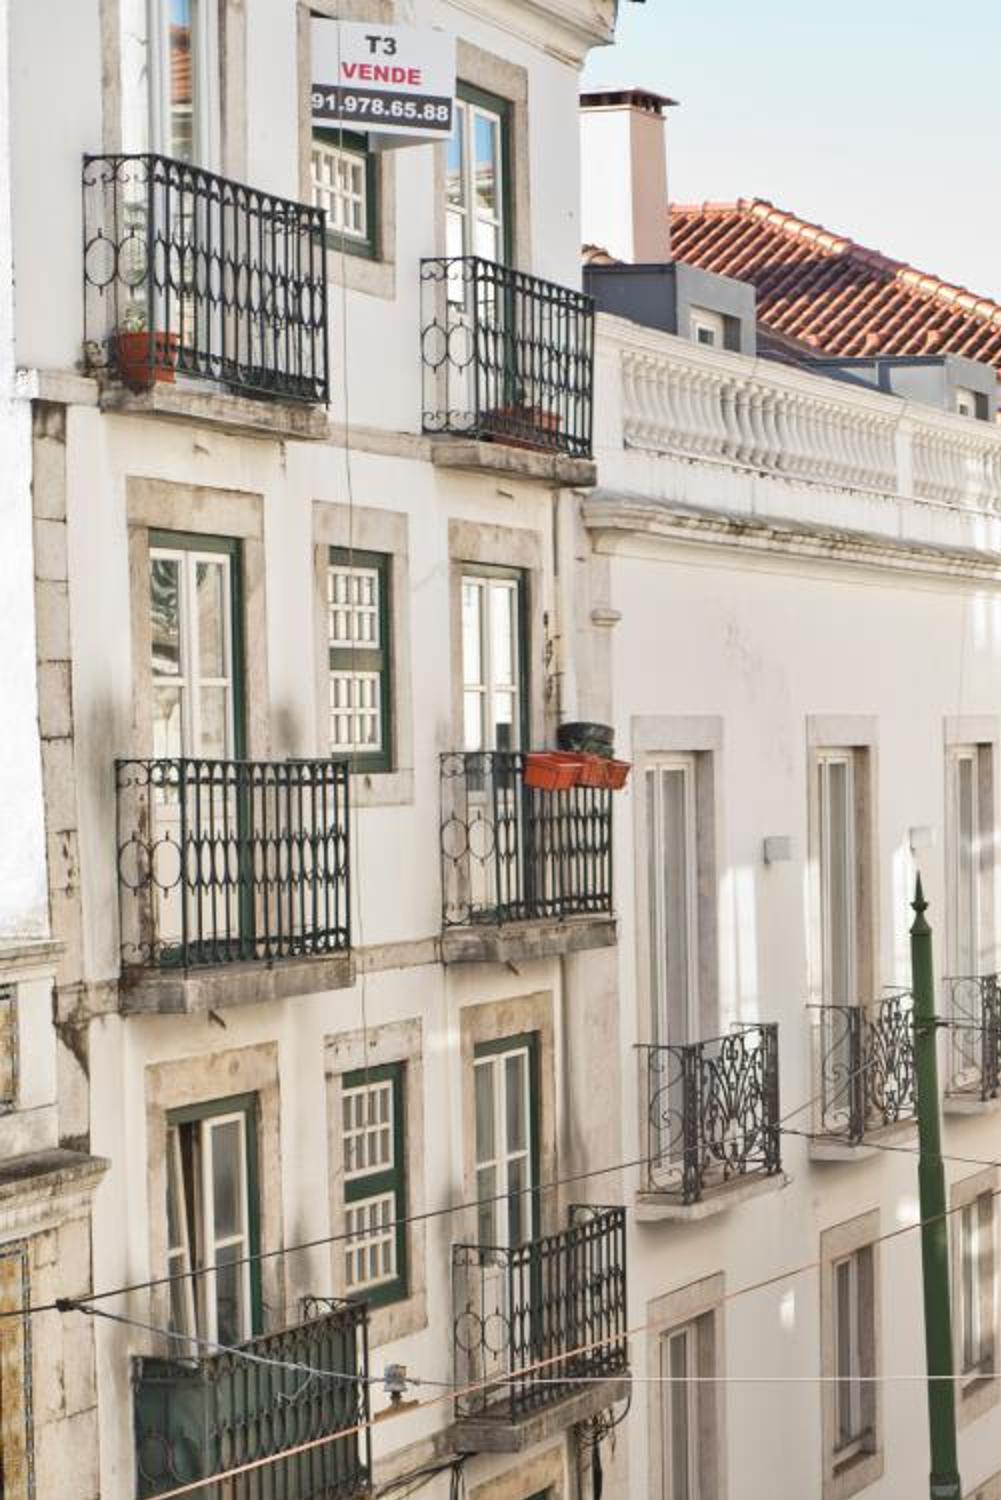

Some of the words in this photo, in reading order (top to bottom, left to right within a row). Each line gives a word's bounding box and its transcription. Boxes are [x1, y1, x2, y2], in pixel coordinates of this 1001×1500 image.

[365, 35, 398, 56] T3
[341, 61, 423, 86] VENDE
[311, 93, 449, 122] 91.978.65.88
